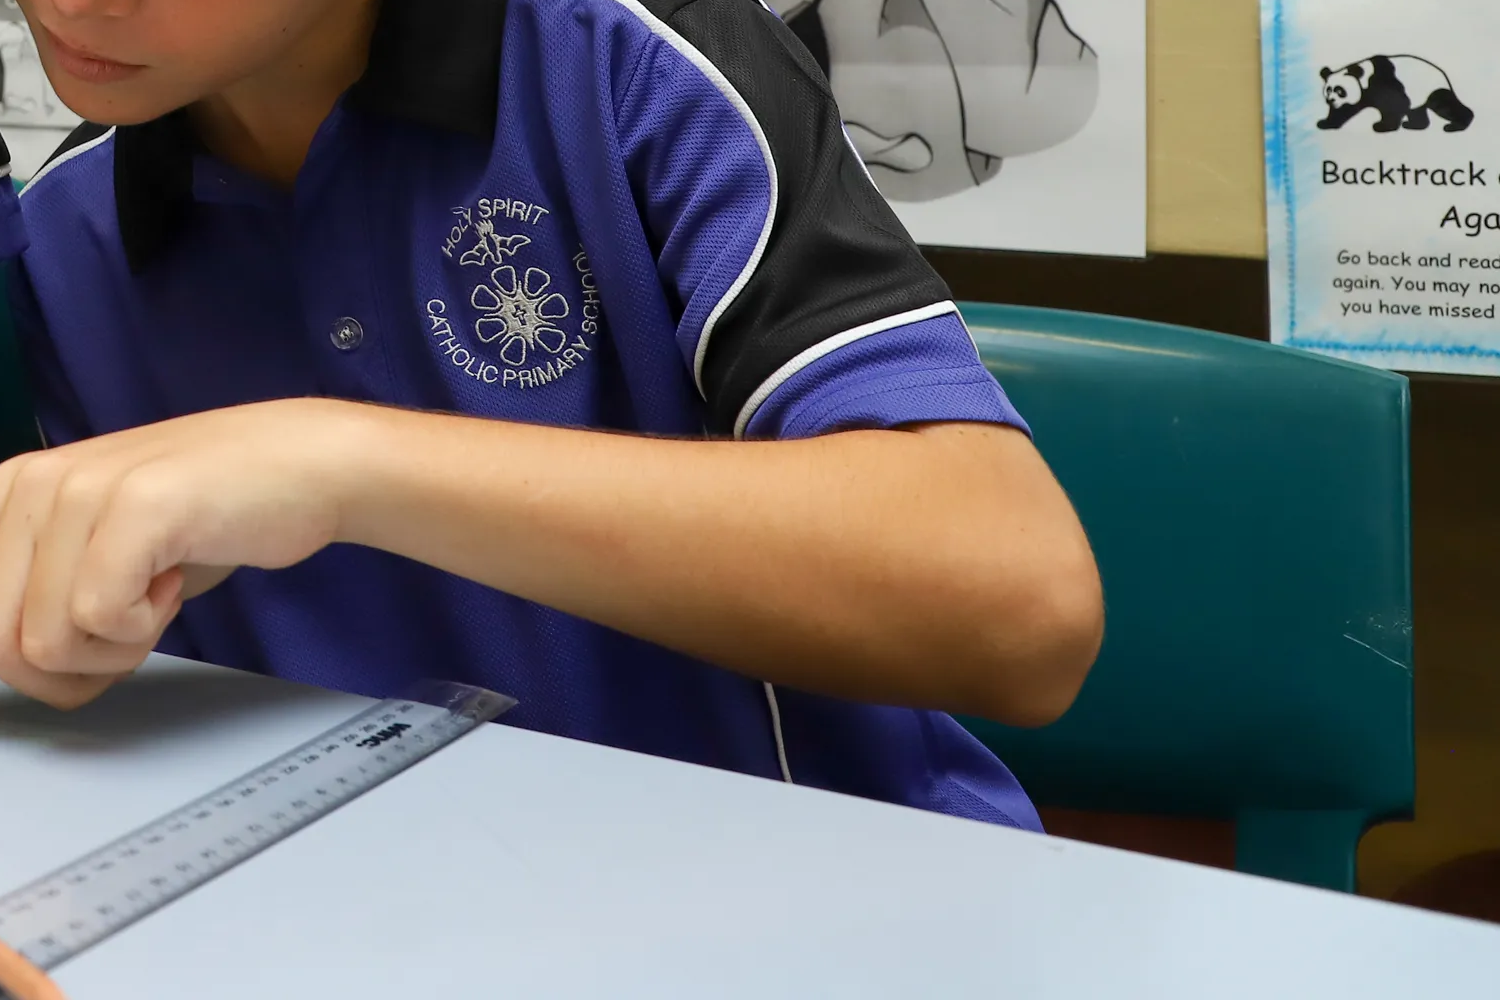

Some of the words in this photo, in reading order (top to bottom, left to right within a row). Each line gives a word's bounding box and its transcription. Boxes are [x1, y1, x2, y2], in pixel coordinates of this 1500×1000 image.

[1322, 160, 1487, 186] Backtrack
[441, 206, 472, 258] HOLY
[477, 197, 550, 225] SPIRIT
[1336, 249, 1361, 265] Go
[1367, 251, 1412, 267] back
[1417, 253, 1451, 268] and
[1332, 275, 1385, 293] again.
[1391, 276, 1426, 291] You
[1432, 280, 1471, 298] may
[1340, 301, 1372, 318] you
[1379, 299, 1422, 316] have
[1428, 302, 1495, 319] missed
[426, 298, 499, 384] CATHOLIC
[502, 334, 592, 390] PRIMARY
